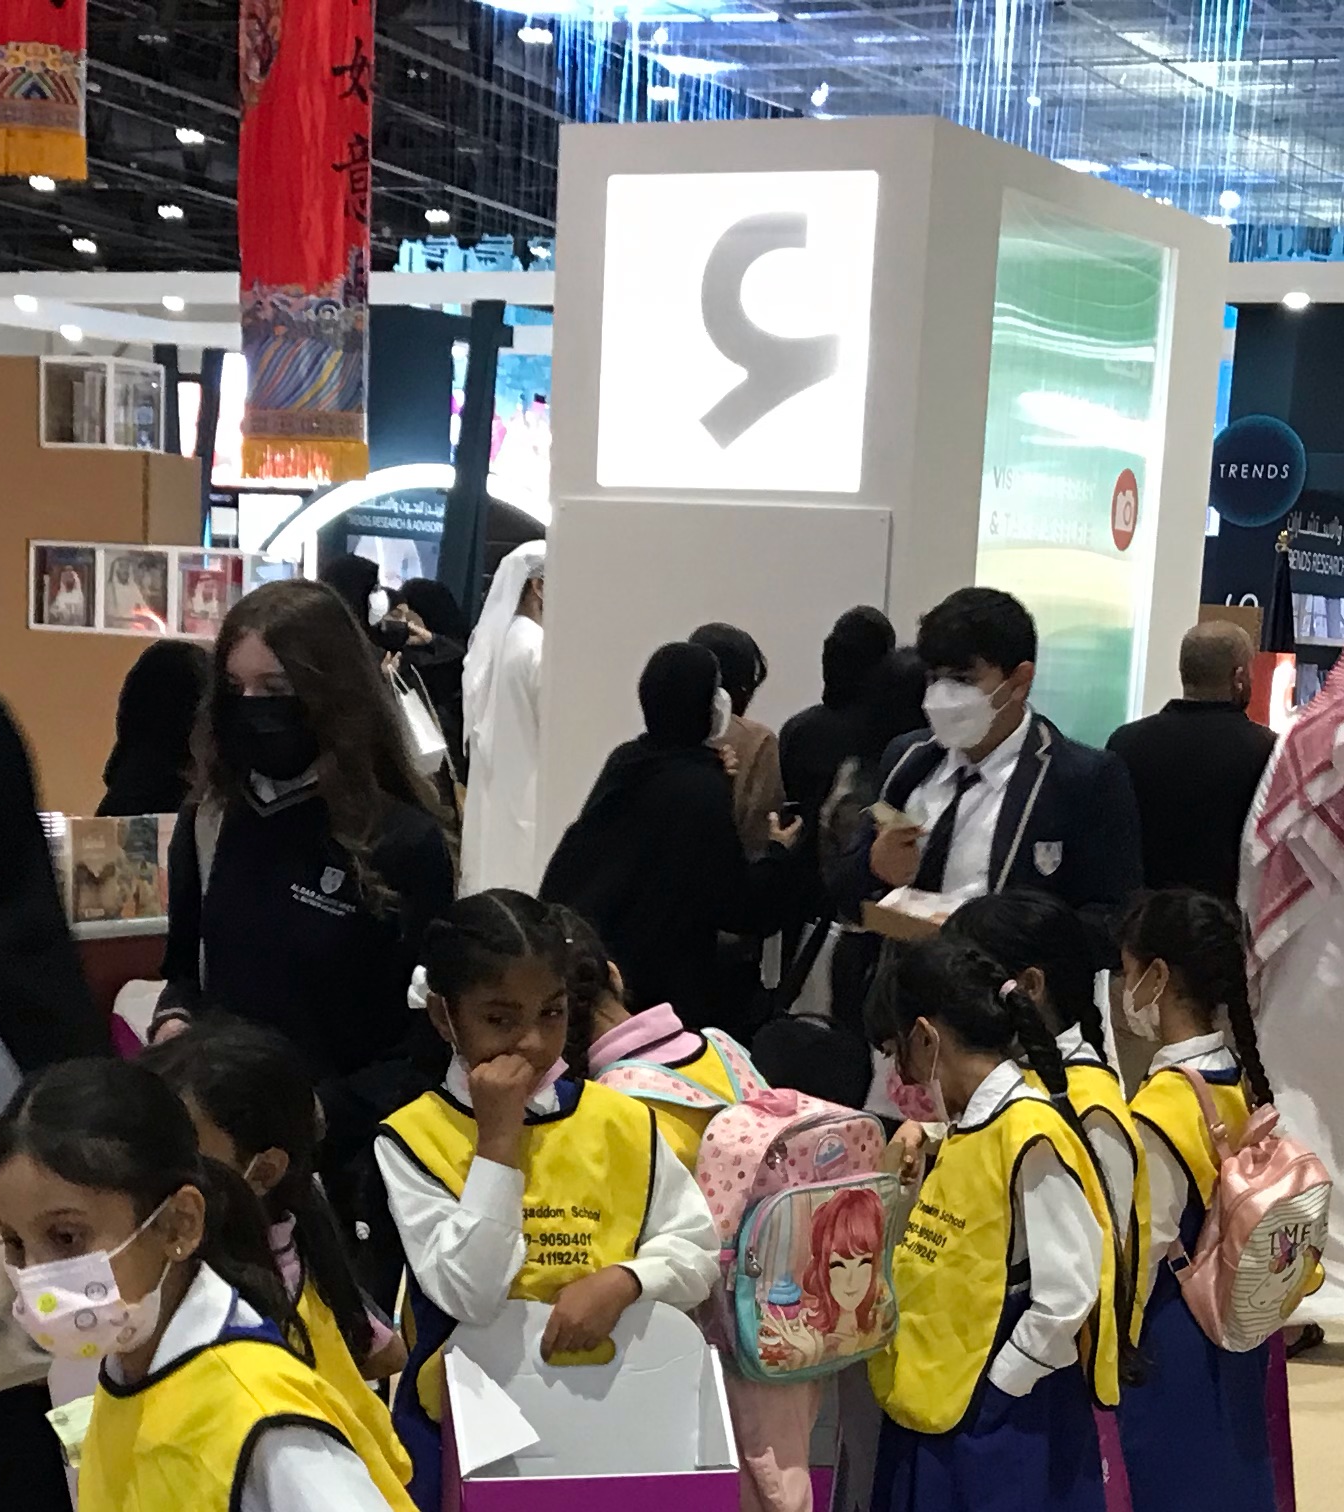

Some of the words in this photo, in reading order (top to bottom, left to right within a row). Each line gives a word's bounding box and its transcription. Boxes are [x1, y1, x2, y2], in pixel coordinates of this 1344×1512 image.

[1219, 463, 1291, 480] TRENDS
[1288, 549, 1311, 572] RENDS
[571, 1205, 601, 1222] School
[523, 1233, 593, 1247] 0-9050401
[524, 1251, 590, 1266] -4119242
